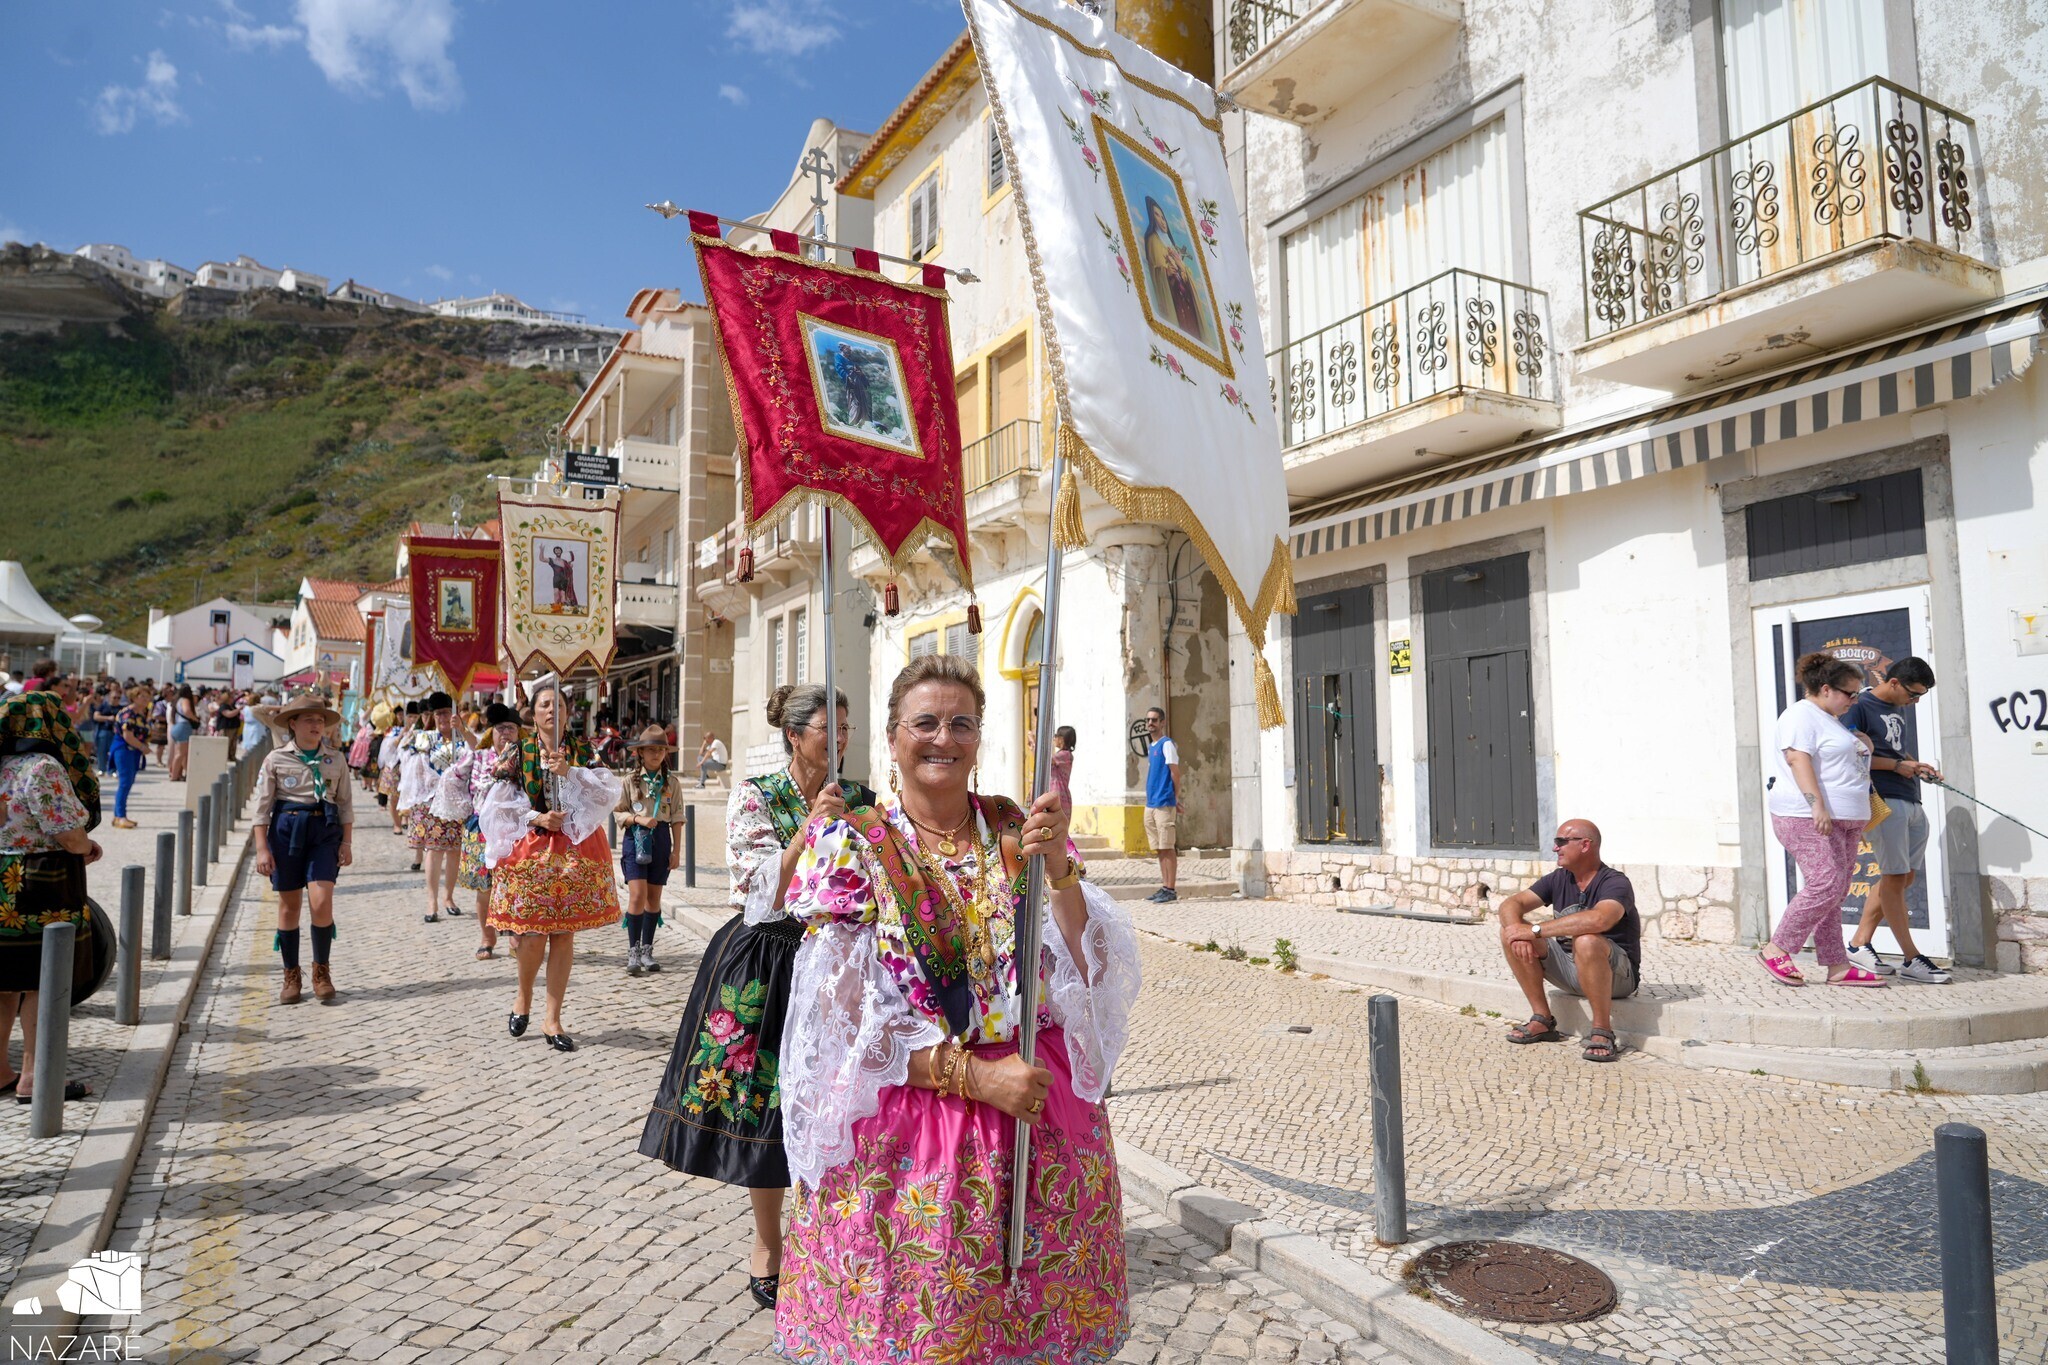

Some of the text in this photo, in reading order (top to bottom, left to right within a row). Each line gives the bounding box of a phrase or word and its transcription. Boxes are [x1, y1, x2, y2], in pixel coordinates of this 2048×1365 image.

[577, 455, 608, 463] QUARTOS
[574, 461, 610, 470] CHAMBRES
[580, 467, 604, 475] ROOMS
[568, 472, 616, 482] HABITACIONES
[1833, 648, 1876, 661] ABOUÇO
